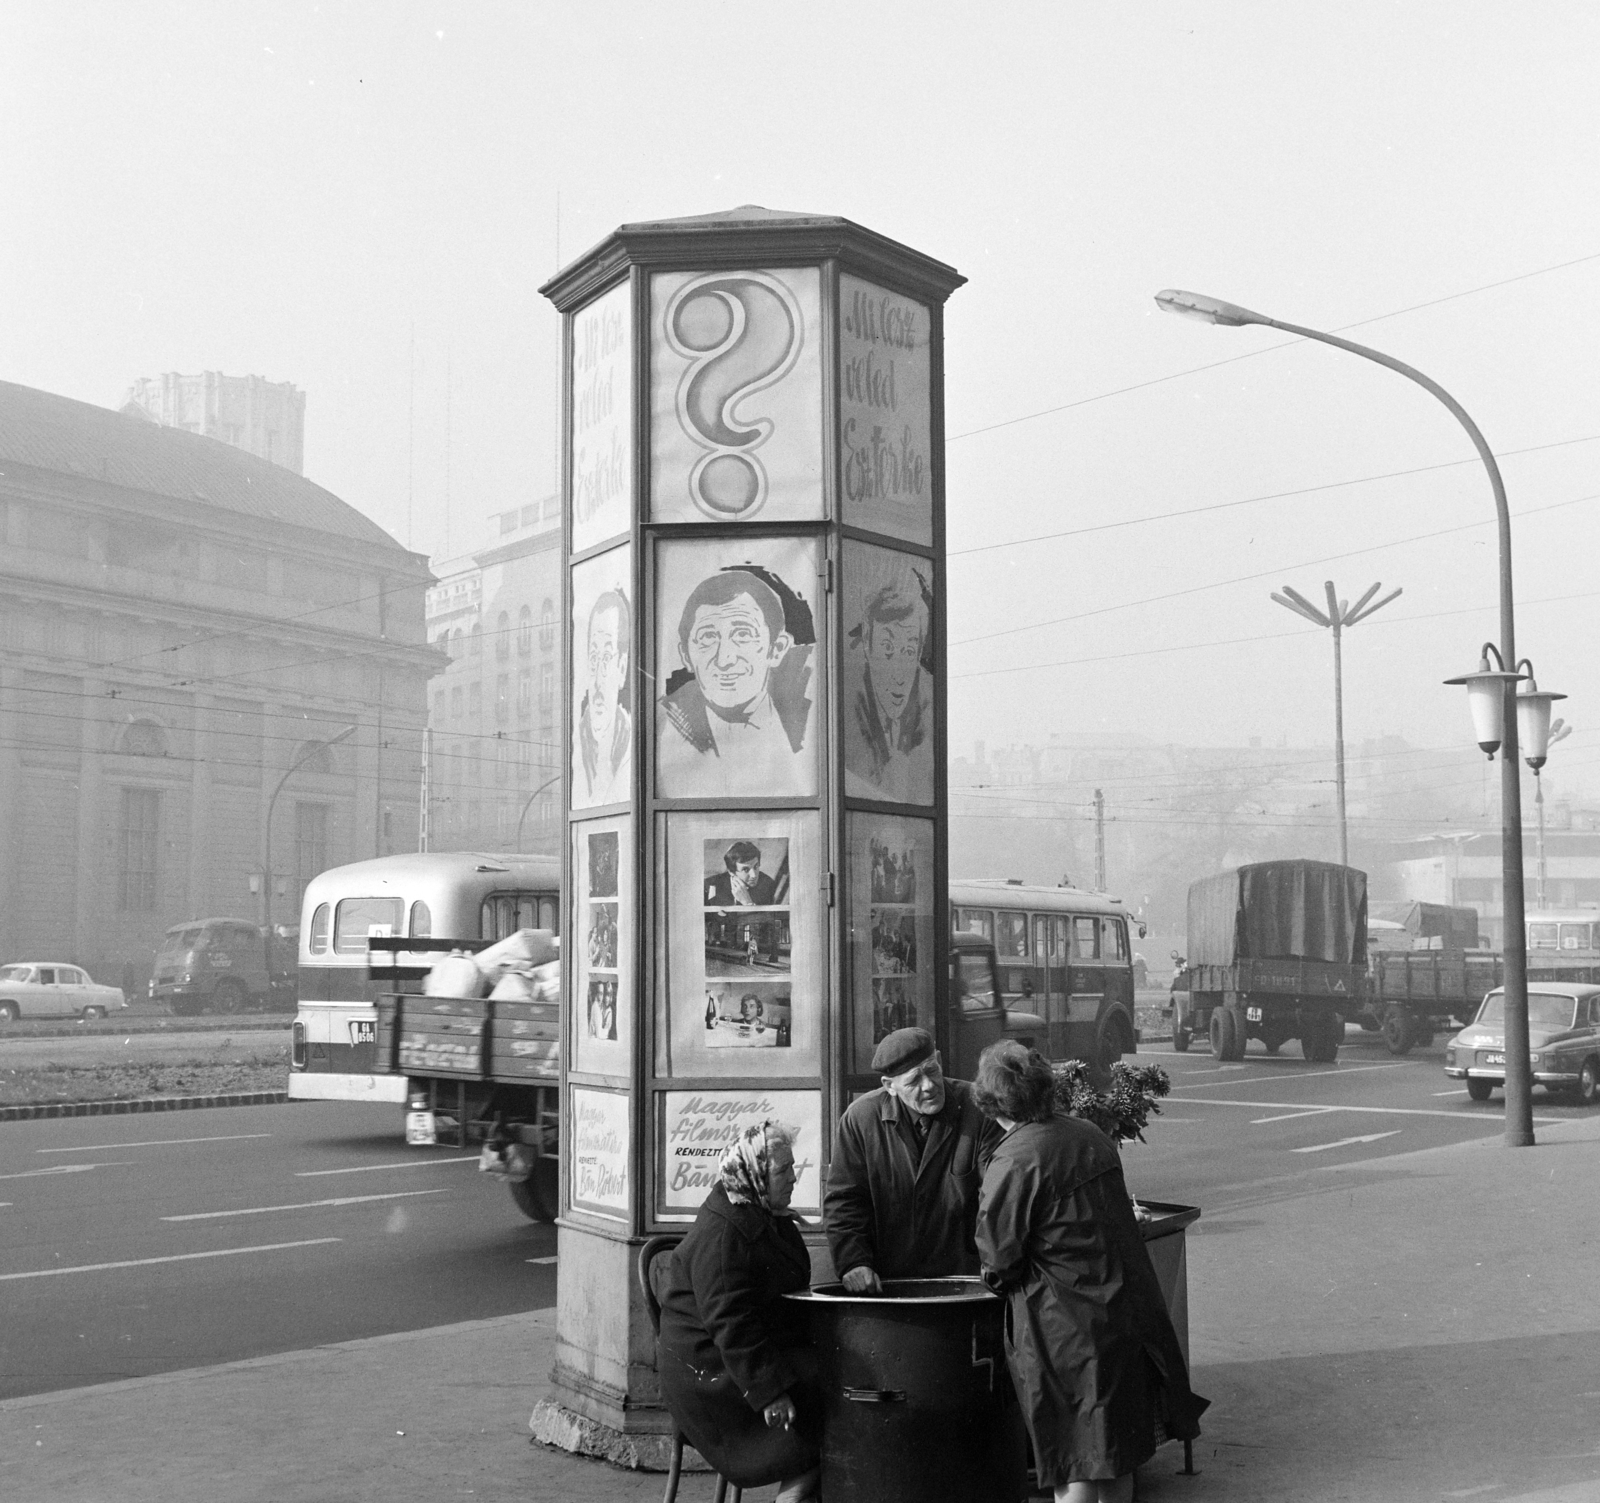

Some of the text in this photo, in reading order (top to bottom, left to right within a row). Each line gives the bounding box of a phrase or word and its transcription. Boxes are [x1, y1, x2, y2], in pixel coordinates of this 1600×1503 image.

[845, 290, 916, 354] Mi lesz
[845, 349, 898, 412] veled
[843, 417, 924, 503] Eszterke
[679, 1096, 774, 1122] Magyar
